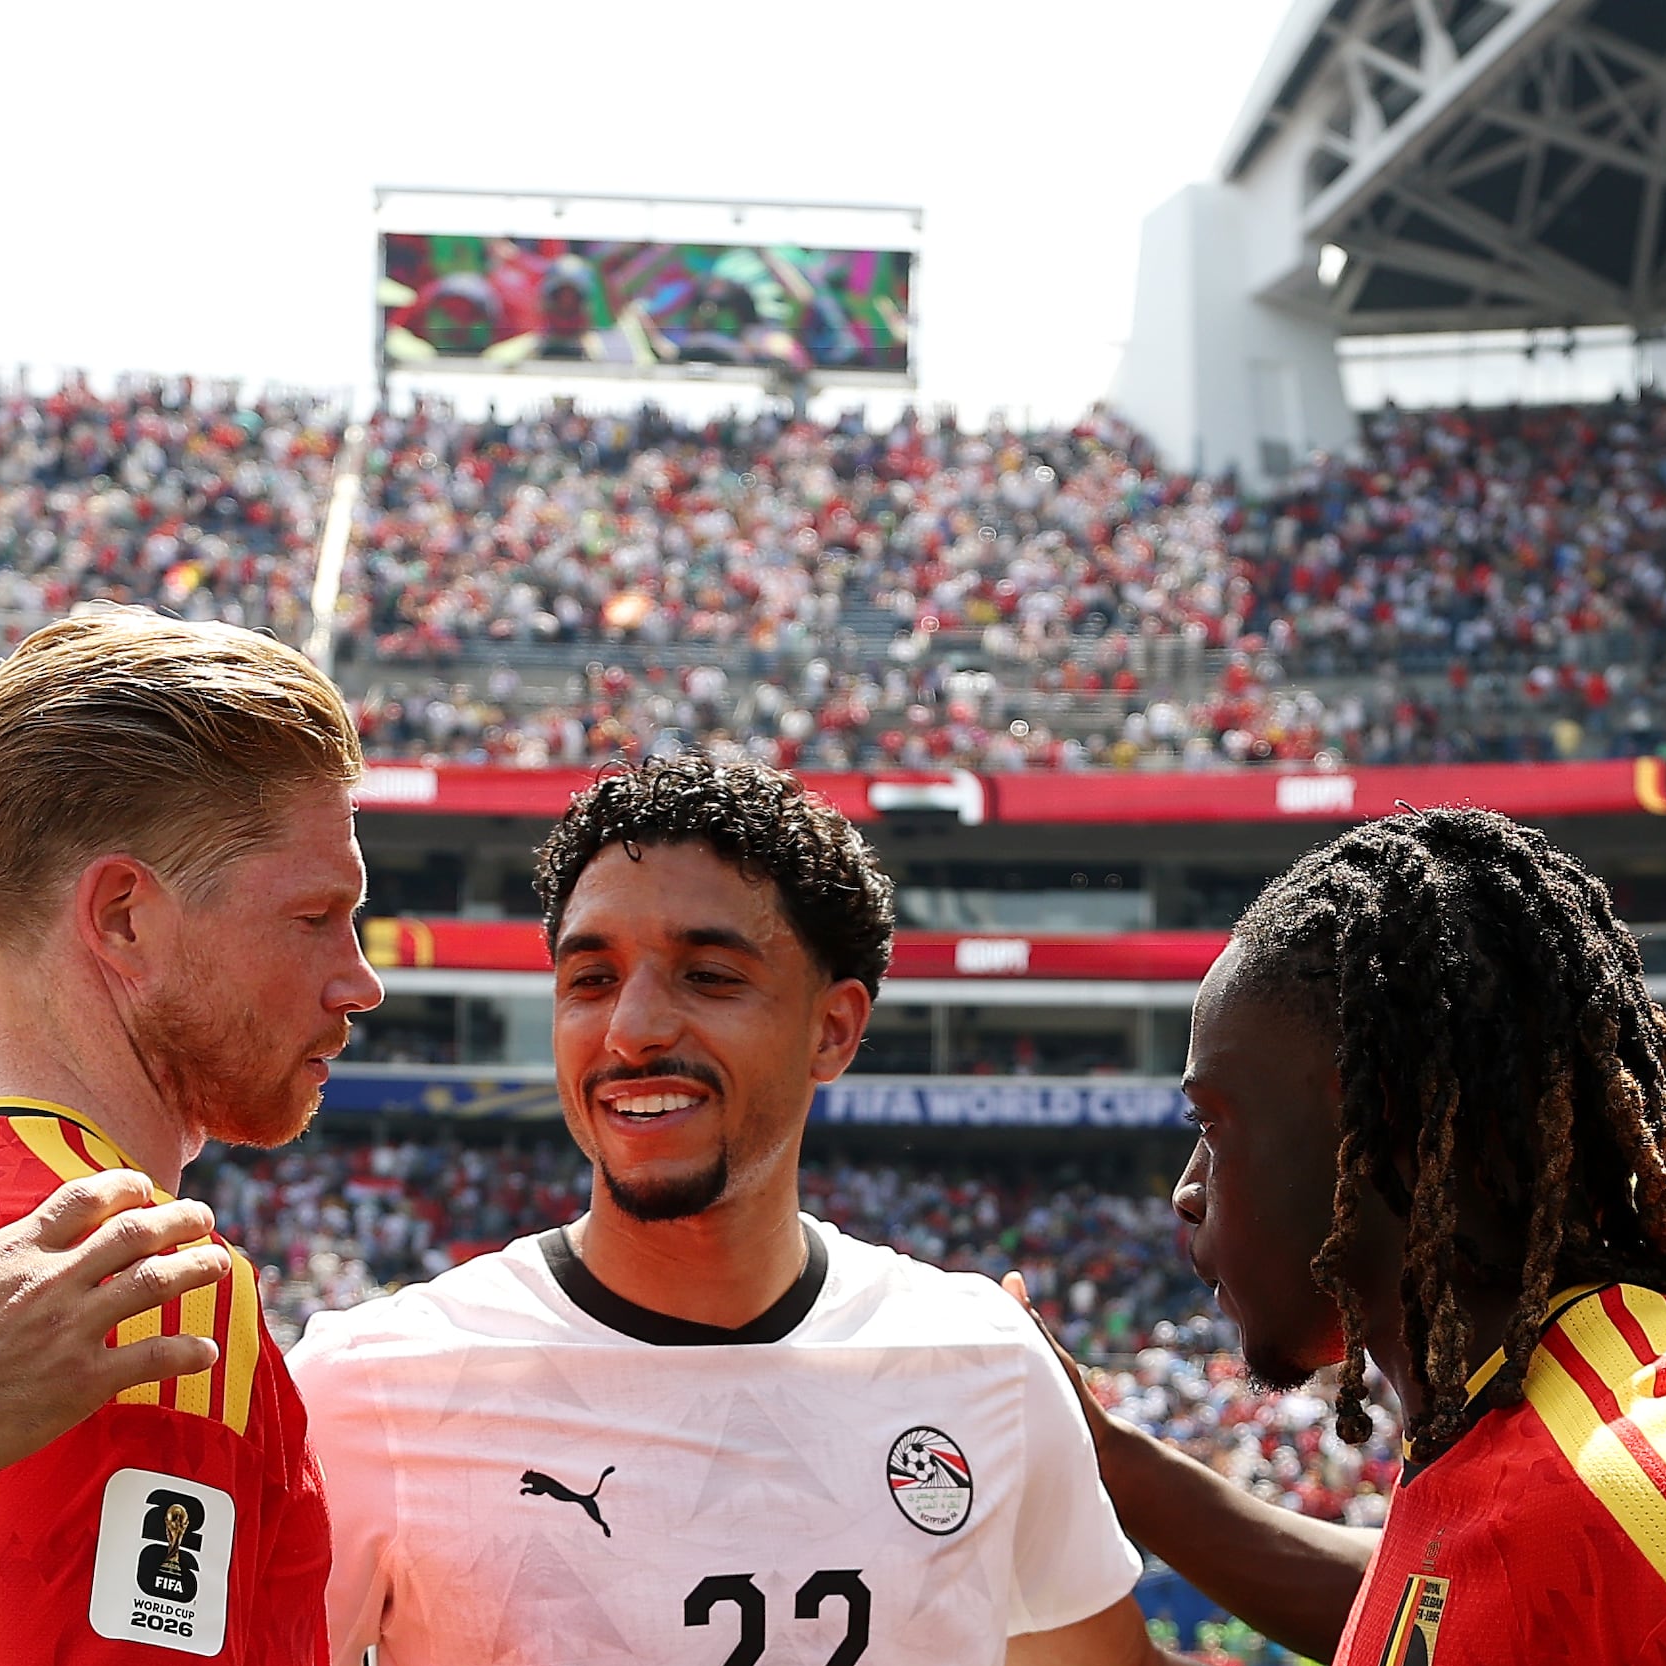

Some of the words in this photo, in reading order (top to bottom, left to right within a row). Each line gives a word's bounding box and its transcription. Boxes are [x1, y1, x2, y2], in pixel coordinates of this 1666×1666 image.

[824, 1086, 922, 1123] FIFA
[927, 1088, 1082, 1125] WORLD
[1087, 1089, 1171, 1127] CUP
[920, 1512, 951, 1524] EGYPTIAN
[154, 1576, 183, 1593] FIFA
[133, 1598, 173, 1615] WORLD
[175, 1607, 195, 1620] CUP
[131, 1611, 194, 1638] 2026
